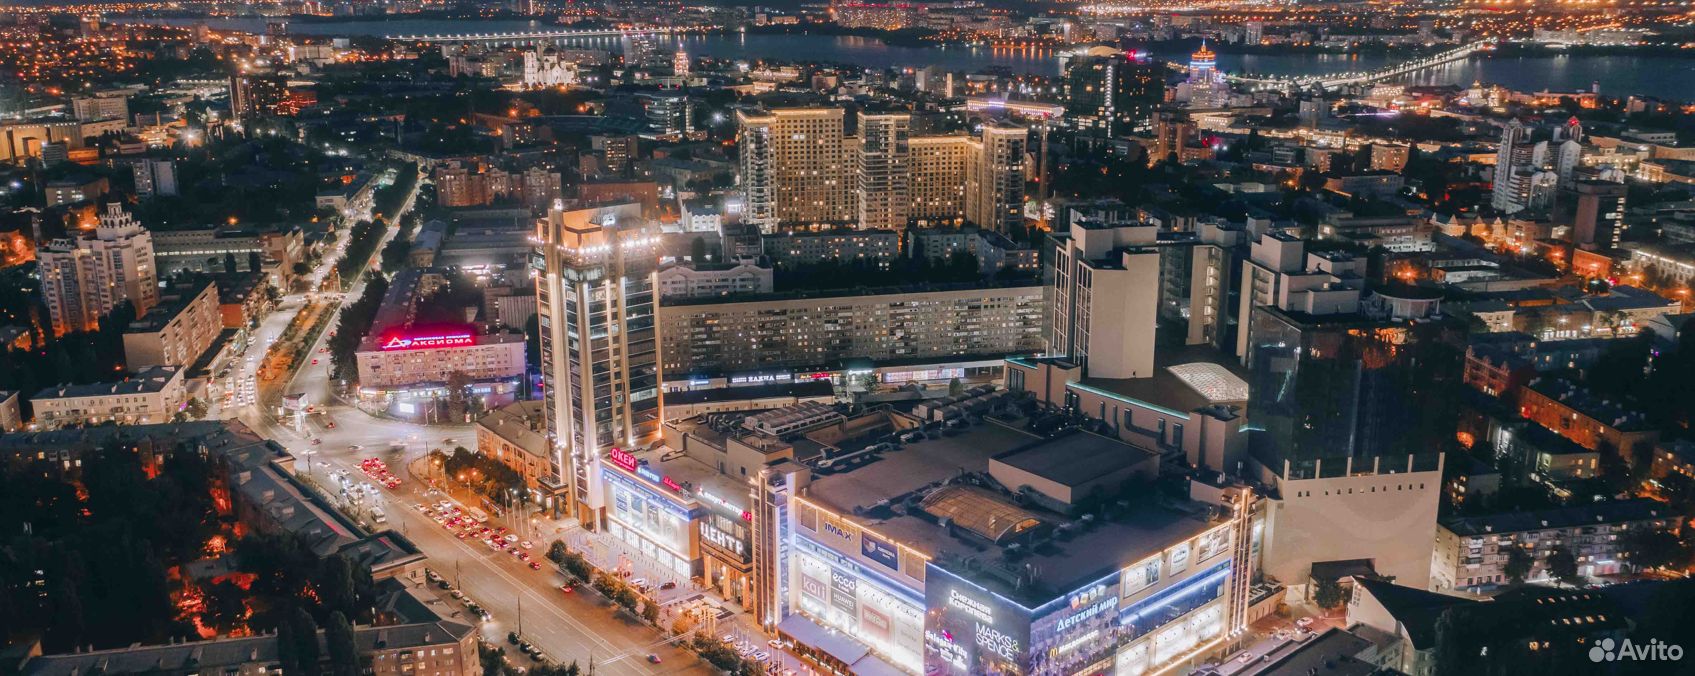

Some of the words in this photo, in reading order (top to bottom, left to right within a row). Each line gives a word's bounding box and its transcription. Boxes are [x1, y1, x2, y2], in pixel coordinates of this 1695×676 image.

[411, 338, 473, 347] АКСИОМА
[700, 521, 744, 555] ЦЕНТР
[825, 523, 852, 541] IMAX
[833, 573, 855, 590] ecco
[1057, 603, 1098, 632] Детский
[1099, 596, 1118, 612] мир
[975, 621, 1012, 649] MARKS
[1012, 640, 1019, 652] &
